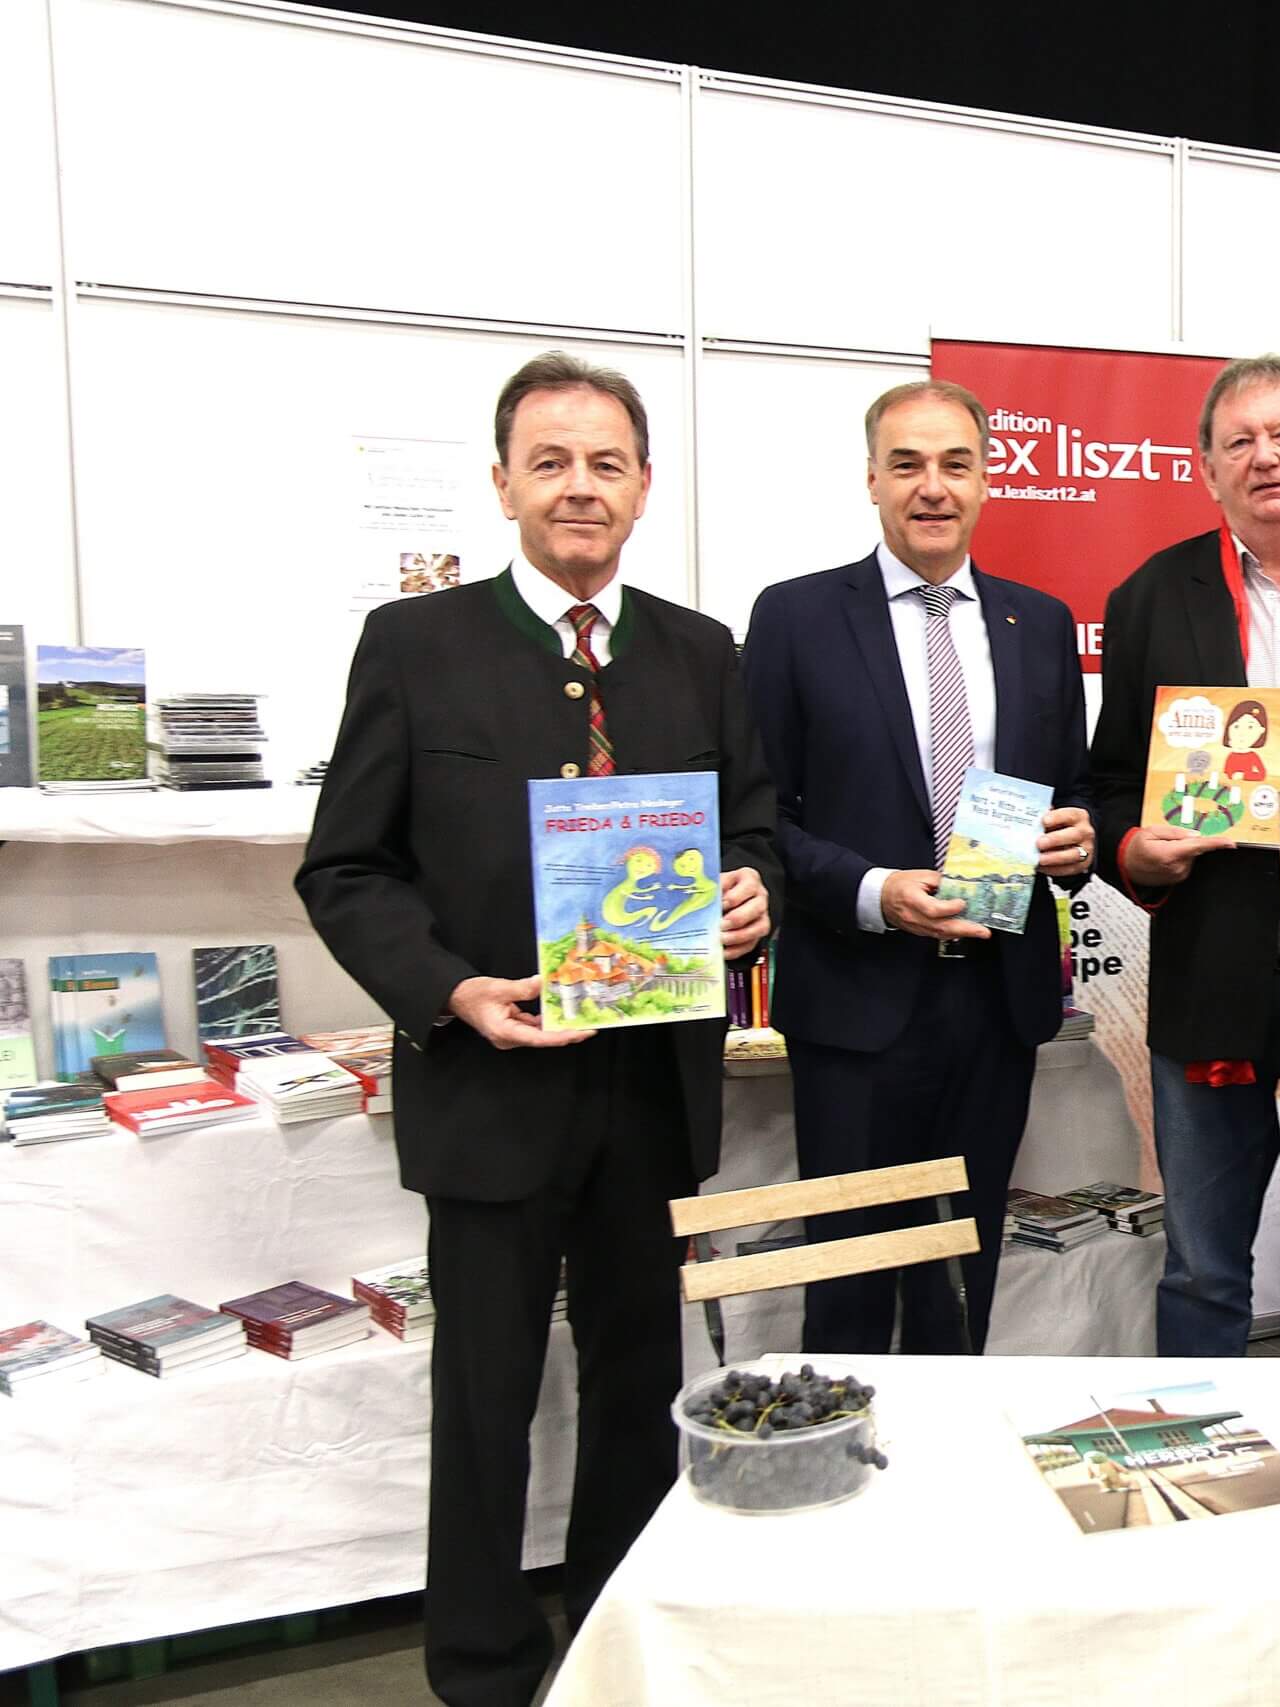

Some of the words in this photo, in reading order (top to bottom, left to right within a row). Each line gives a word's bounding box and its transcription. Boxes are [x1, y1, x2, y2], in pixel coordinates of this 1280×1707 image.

[988, 408, 1052, 433] dition
[986, 437, 1040, 476] ex
[1057, 424, 1192, 481] liszt
[988, 485, 1096, 502] w.lexliszt12.at
[1168, 710, 1216, 729] Anna
[544, 815, 614, 834] FRIEDA
[619, 815, 631, 830] &
[638, 810, 706, 829] FRIEDO
[1122, 1444, 1222, 1468] HERBST
